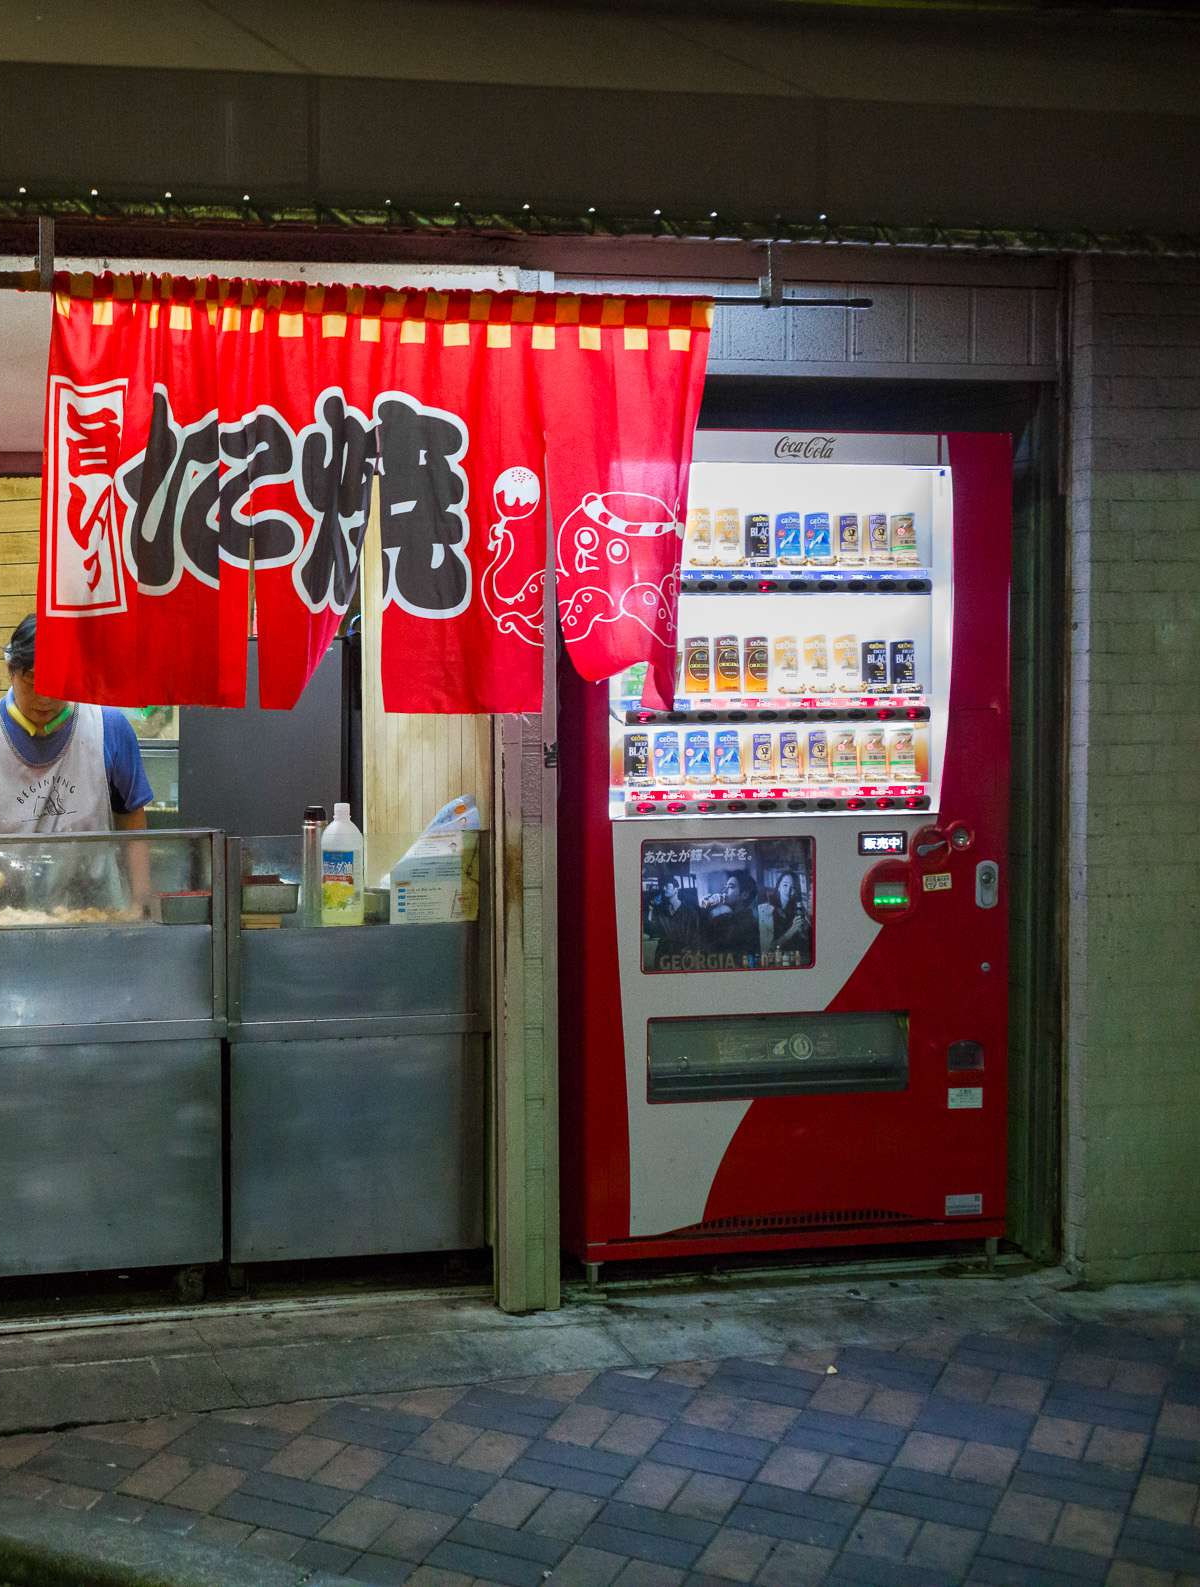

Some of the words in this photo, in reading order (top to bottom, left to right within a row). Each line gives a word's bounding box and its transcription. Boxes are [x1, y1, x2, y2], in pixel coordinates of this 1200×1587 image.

[774, 436, 837, 458] Coca-Cola
[115, 383, 472, 619] たこ焼
[750, 527, 769, 537] BLAC
[867, 654, 886, 664] BLAC
[896, 654, 915, 664] BLAC
[629, 747, 648, 756] BLAC
[864, 837, 901, 850] 販売中
[644, 843, 752, 864] あなたが輝く一杯を。
[323, 861, 353, 874] サラダ油
[660, 948, 736, 971] GEORGIA
